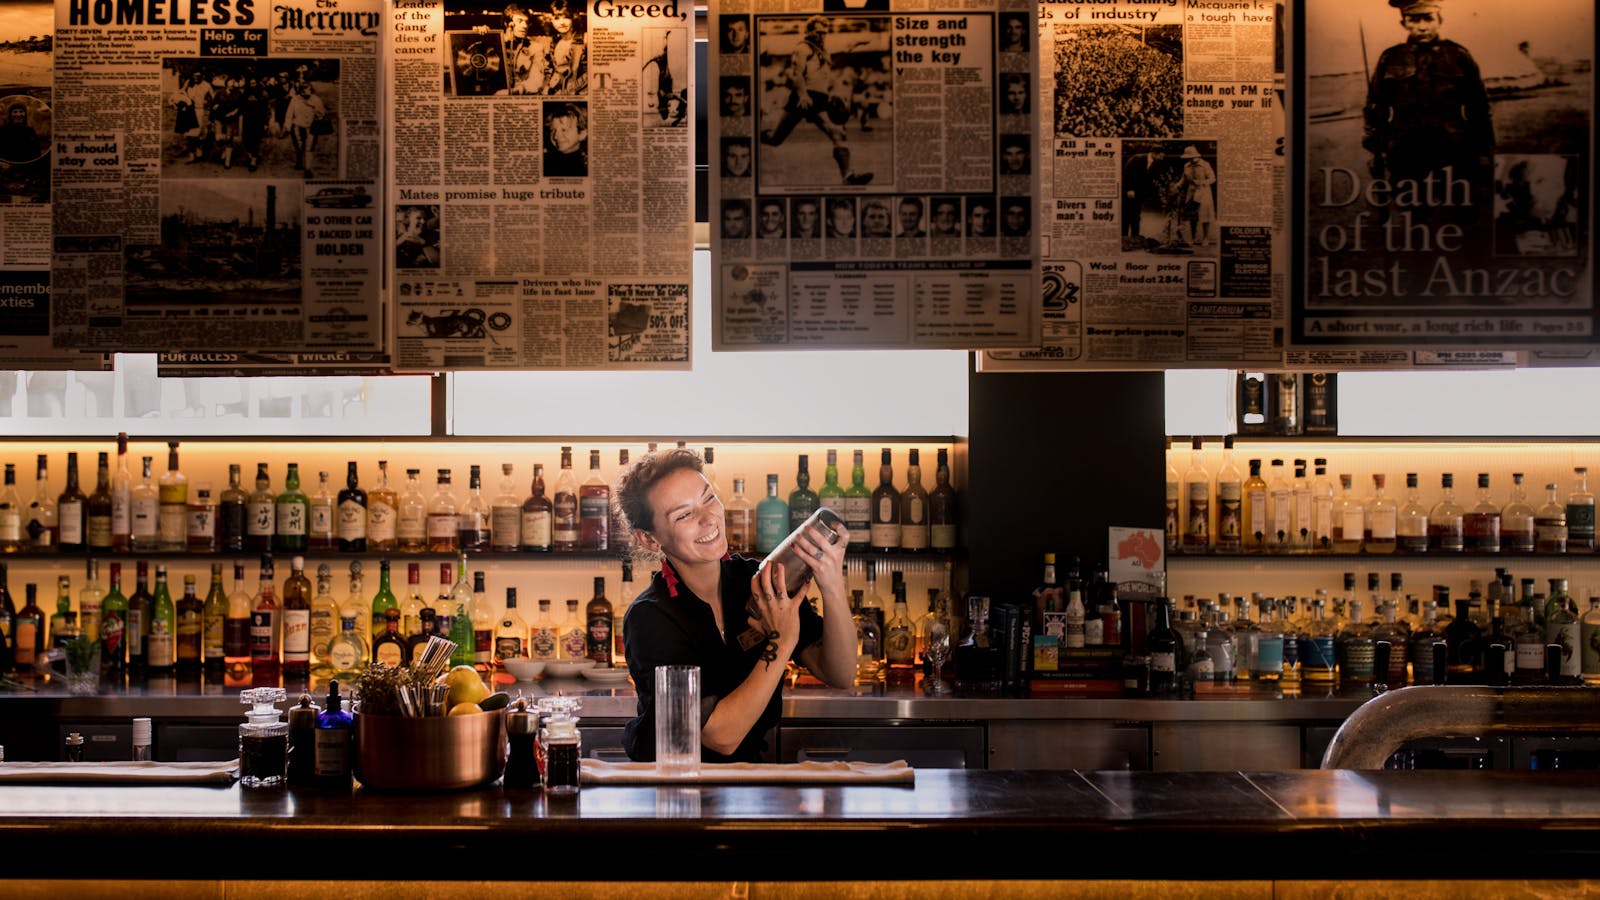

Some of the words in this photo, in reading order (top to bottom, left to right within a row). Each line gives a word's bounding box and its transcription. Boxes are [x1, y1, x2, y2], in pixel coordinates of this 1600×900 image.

[316, 0, 338, 8] The
[395, 0, 438, 9] Leader
[1187, 0, 1250, 11] Macquarie
[69, 0, 255, 25] HOMELESS
[395, 12, 407, 20] of
[411, 12, 430, 20] the
[594, 0, 687, 21] Greed,
[1065, 7, 1080, 19] of
[1092, 7, 1161, 21] industry'
[274, 5, 380, 37] Mercury
[896, 17, 929, 30] Size
[937, 17, 967, 30] and
[1201, 13, 1235, 23] tough
[395, 23, 426, 32] Gang
[204, 30, 235, 42] Help
[244, 30, 262, 40] for
[395, 34, 418, 43] dies
[424, 34, 436, 43] of
[896, 34, 966, 48] strength
[210, 44, 255, 54] victims
[897, 51, 923, 63] the
[932, 51, 961, 65] key
[1187, 85, 1213, 95] PMM
[1219, 85, 1235, 95] not
[1241, 85, 1257, 95] PM
[1187, 97, 1224, 110] change
[1231, 99, 1254, 110] your
[57, 143, 67, 153] It
[74, 143, 117, 153] should
[1056, 149, 1088, 158] Royal
[1094, 149, 1115, 158] day
[58, 156, 86, 167] stay
[93, 155, 118, 165] cool
[1319, 166, 1472, 208] Death
[400, 189, 440, 200] Mates
[445, 190, 497, 202] promise
[503, 189, 534, 201] huge
[540, 189, 585, 199] tribute
[1057, 201, 1086, 209] Divers
[1095, 201, 1113, 209] find
[1057, 211, 1084, 221] man's
[1093, 211, 1114, 222] body
[1319, 212, 1370, 252] of
[1383, 212, 1464, 252] the
[316, 244, 364, 256] HOLDEN
[1157, 263, 1181, 272] price
[1120, 275, 1144, 284] fixed
[1158, 275, 1184, 284] 284c
[1318, 256, 1408, 297] last
[1419, 256, 1576, 297] Anzac
[0, 284, 50, 294] membe
[650, 315, 667, 328] 50%
[670, 315, 683, 328] OFF
[1310, 320, 1323, 332] A
[1327, 320, 1370, 332] short
[1373, 322, 1408, 334] war,
[1411, 323, 1420, 332] a
[1427, 320, 1460, 335] long
[1464, 320, 1493, 332] rich
[1500, 320, 1523, 332] life
